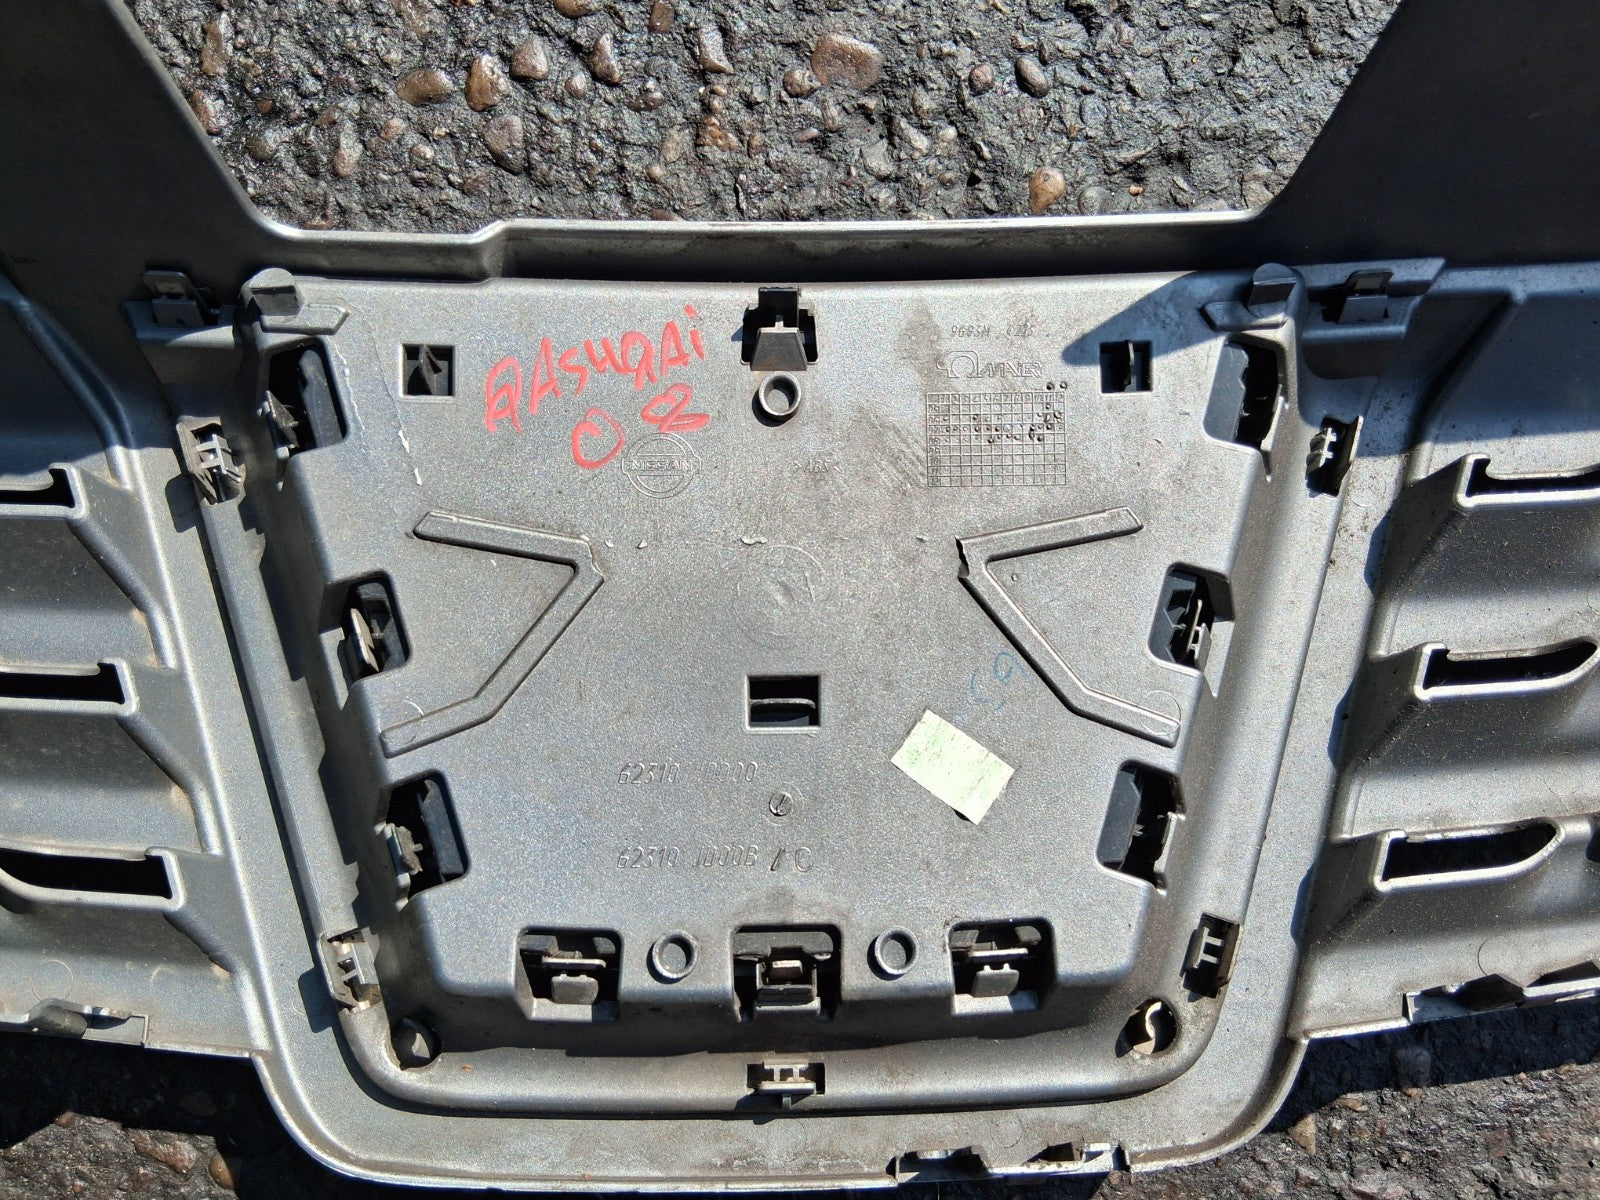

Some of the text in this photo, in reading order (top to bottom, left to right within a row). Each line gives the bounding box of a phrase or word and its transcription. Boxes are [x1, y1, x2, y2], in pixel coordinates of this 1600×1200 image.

[628, 459, 693, 471] NISSAN
[617, 762, 680, 785] 62310
[616, 846, 680, 868] 62310
